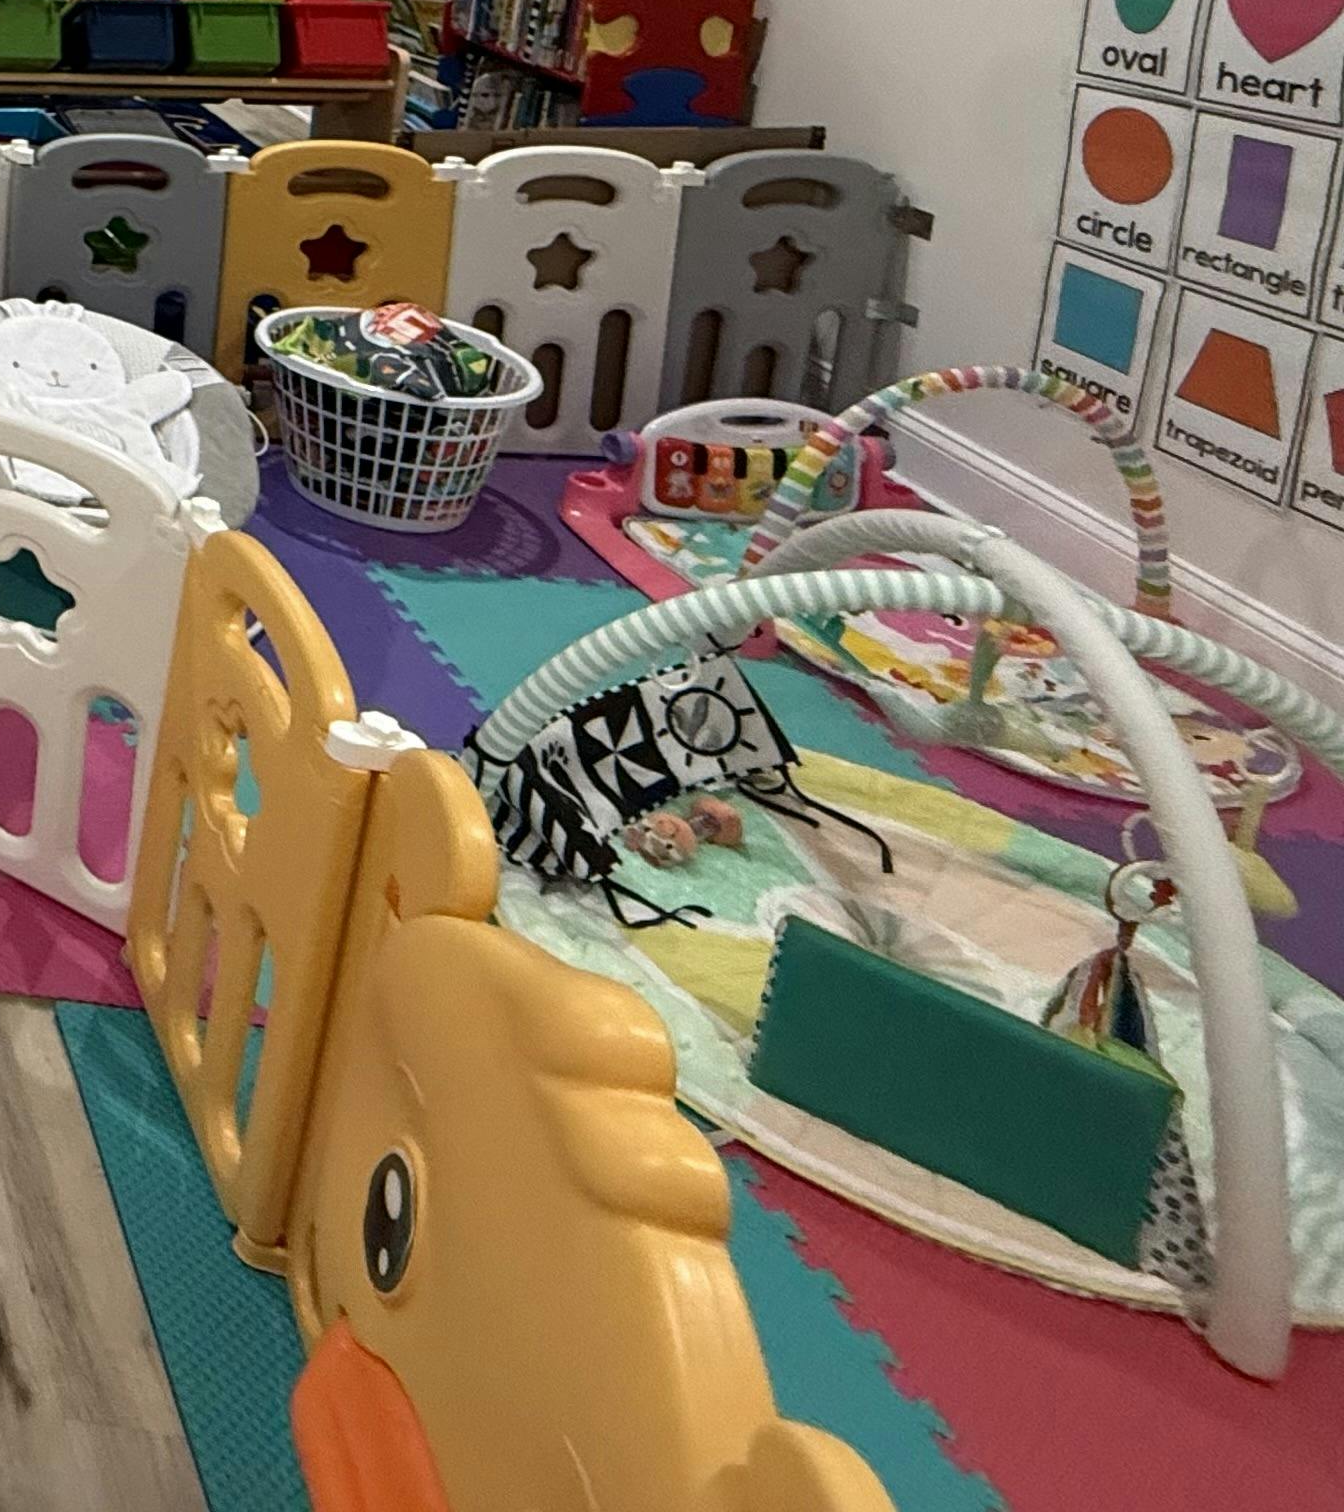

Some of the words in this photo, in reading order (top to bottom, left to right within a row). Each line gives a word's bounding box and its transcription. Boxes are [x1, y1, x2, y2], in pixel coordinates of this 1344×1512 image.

[1101, 44, 1168, 78] oval
[1217, 61, 1325, 109] heart
[1076, 208, 1153, 256] circle
[1182, 242, 1307, 297] rectangle
[1165, 418, 1279, 486] trapezoid
